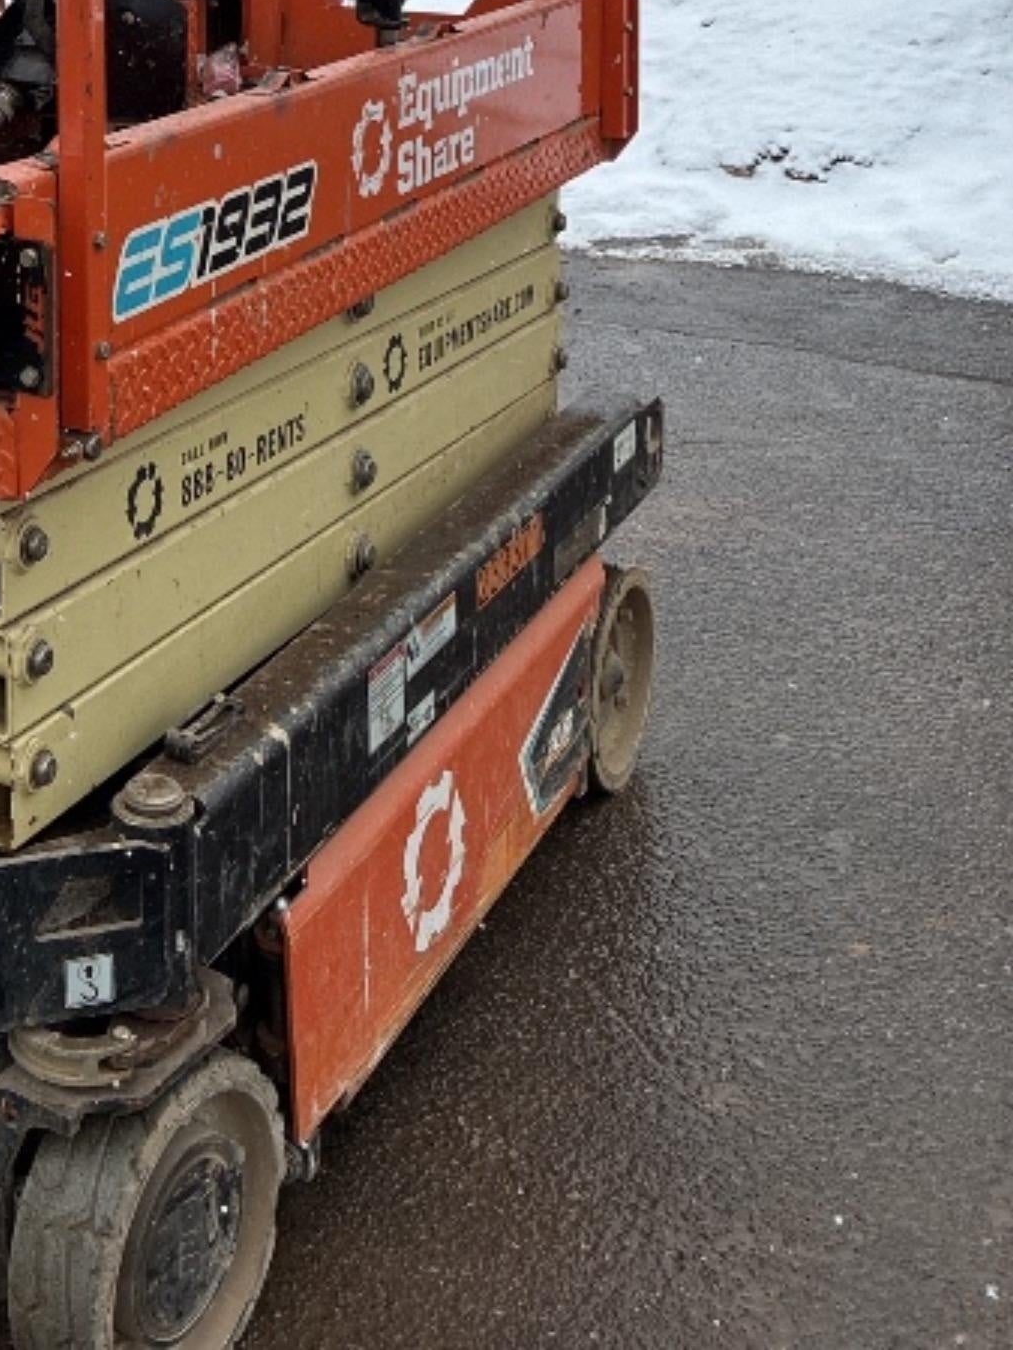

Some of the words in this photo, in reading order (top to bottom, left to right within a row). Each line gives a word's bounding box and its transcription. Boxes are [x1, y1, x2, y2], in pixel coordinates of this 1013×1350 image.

[397, 35, 534, 130] Equipment
[397, 126, 475, 196] Share
[113, 159, 318, 324] ES1932
